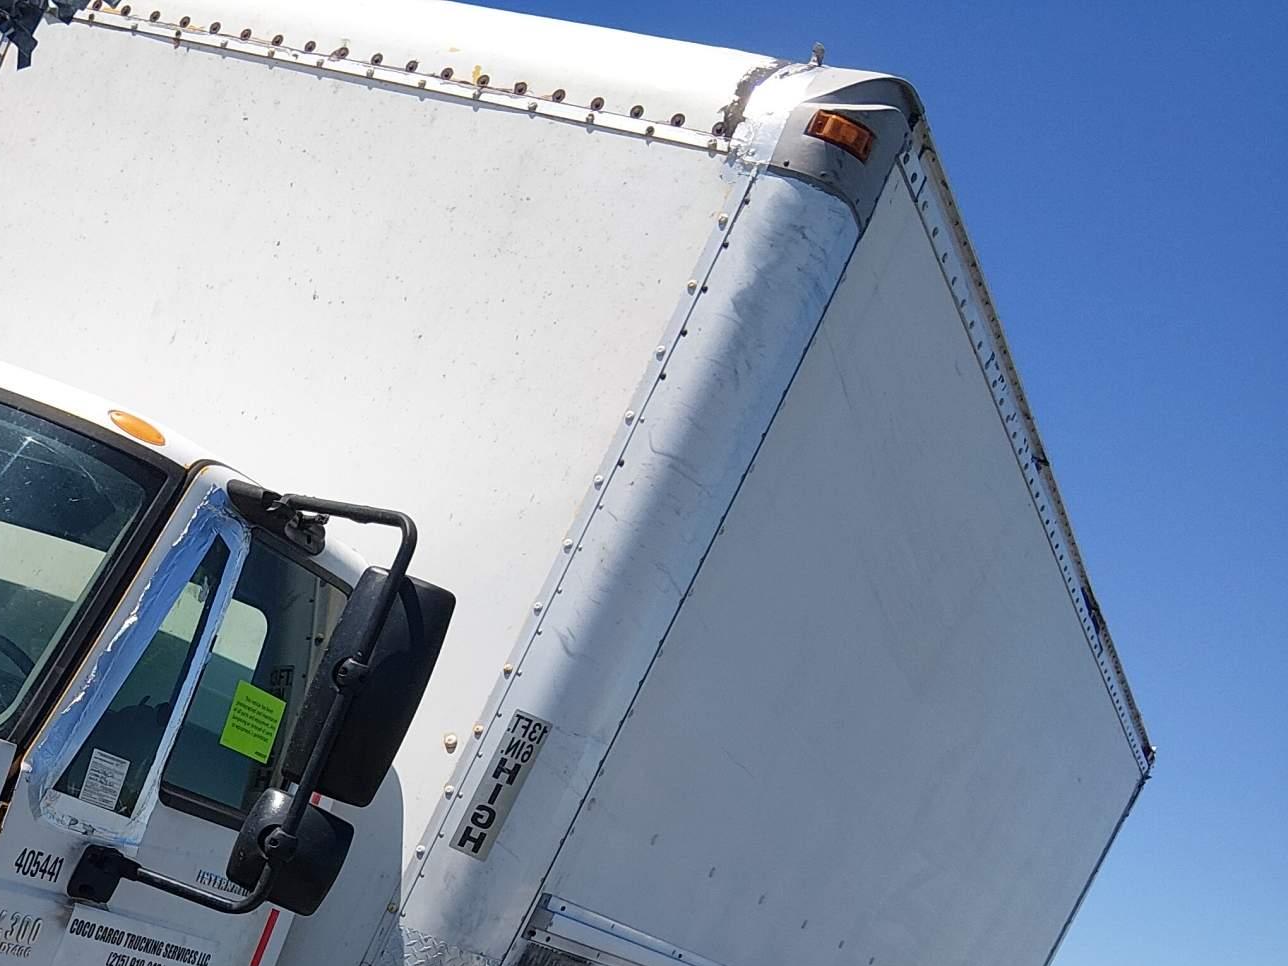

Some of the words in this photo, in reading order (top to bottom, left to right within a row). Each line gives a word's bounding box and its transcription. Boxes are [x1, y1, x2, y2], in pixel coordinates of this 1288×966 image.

[14, 847, 65, 883] 405441
[69, 918, 97, 939] COCO
[94, 925, 124, 946] CARGO
[122, 932, 164, 957] TRUCKING
[162, 943, 199, 966] SERVICES
